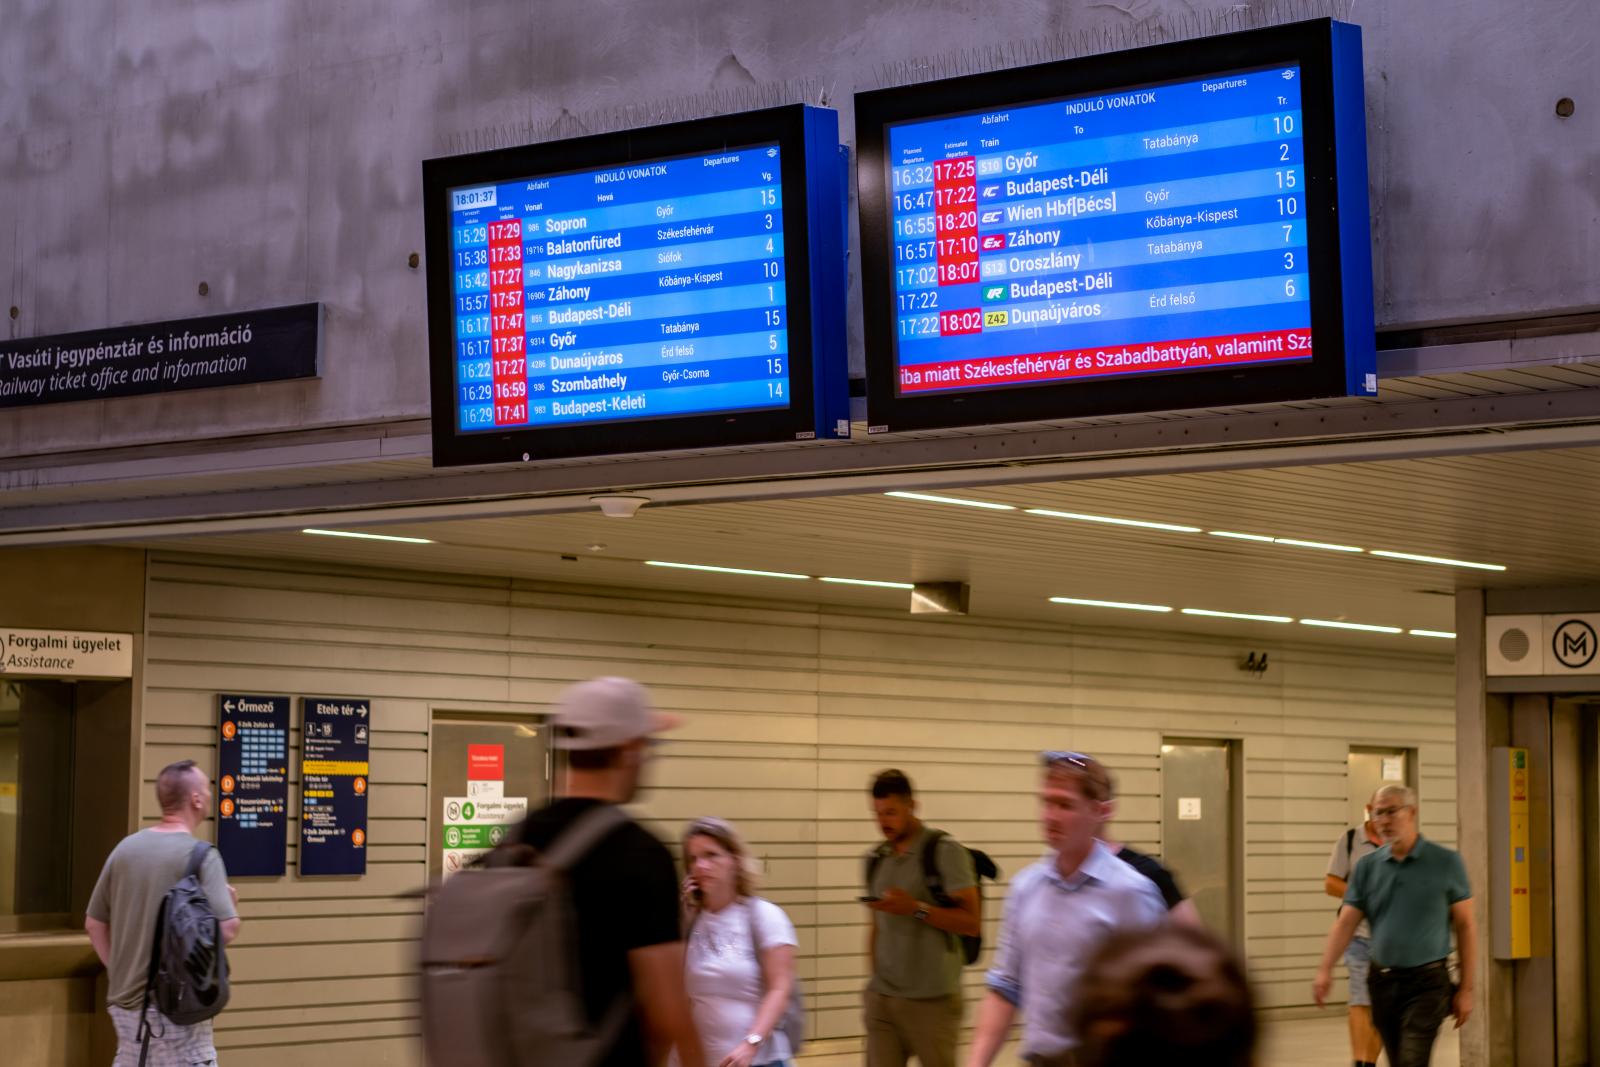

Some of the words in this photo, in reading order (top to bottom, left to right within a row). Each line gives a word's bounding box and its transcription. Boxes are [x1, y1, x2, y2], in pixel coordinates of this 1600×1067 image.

[1066, 98, 1103, 115] INDULÓ
[1107, 92, 1155, 109] VONATOK
[1202, 79, 1247, 92] Departures
[1277, 96, 1288, 105] Tr.
[982, 114, 1009, 125] Abfahrt
[1074, 126, 1083, 134] To
[704, 155, 739, 167] Departures
[894, 167, 932, 186] 16:32
[935, 161, 975, 180] 17:25
[981, 162, 999, 172] S10
[1006, 153, 1038, 173] Győr
[1144, 134, 1198, 149] Tatabánya
[1273, 116, 1294, 135] 10
[981, 138, 999, 148] Train
[527, 181, 549, 191] Abfahrt
[595, 171, 625, 184] INDULÓ
[628, 166, 667, 179] VONATOK
[762, 172, 773, 181] Vg.
[895, 192, 933, 211] 16:47
[936, 186, 976, 206] 17:22
[1007, 168, 1108, 197] Budapest-Déli
[1280, 144, 1289, 161] 2
[456, 191, 493, 206] 18:01:37
[525, 203, 543, 211] Vonat
[597, 194, 613, 202] Hová
[896, 217, 934, 236] 16:55
[937, 211, 977, 231] 18:20
[982, 211, 1002, 223] EC
[1007, 203, 1042, 222] Wien
[1047, 192, 1116, 217] Hbf[Bécs]
[1146, 189, 1169, 205] Győr
[1276, 170, 1296, 188] 15
[458, 228, 486, 245] 15:29
[491, 223, 520, 240] 17:29
[546, 217, 586, 234] Sopron
[657, 206, 674, 218] Győr
[761, 189, 775, 205] 15
[897, 242, 936, 260] 16:57
[938, 237, 978, 256] 17:10
[983, 238, 1003, 248] Ex
[1008, 230, 1060, 247] Záhony
[1146, 208, 1238, 229] Kőbánya-Kispest
[1277, 198, 1297, 216] 10
[458, 250, 487, 266] 15:38
[491, 246, 521, 261] 17:33
[547, 233, 621, 256] Balatonfüred
[658, 224, 714, 240] Székesfehérvár
[766, 214, 772, 229] 3
[899, 268, 937, 286] 17:02
[939, 262, 978, 281] 18:07
[1010, 253, 1080, 272] Oroszlány
[1148, 241, 1203, 255] Tatabánya
[1282, 225, 1292, 243] 7
[459, 273, 487, 288] 15:42
[492, 269, 522, 284] 17:27
[548, 259, 622, 280] Nagykanizsa
[658, 251, 681, 264] Siófok
[766, 238, 773, 253] 4
[900, 292, 938, 310] 17:22
[1011, 273, 1112, 299] Budapest-Déli
[1284, 253, 1294, 269] 3
[460, 295, 488, 311] 15:57
[493, 291, 522, 307] 17:57
[548, 287, 590, 302] Záhony
[659, 271, 723, 288] Kőbánya-Kispest
[764, 262, 778, 278] 10
[461, 318, 489, 333] 16:17
[493, 314, 523, 330] 17:47
[549, 302, 631, 324] Budapest-Déli
[768, 286, 774, 301] 1
[901, 317, 939, 335] 17:22
[941, 313, 981, 331] 18:02
[988, 314, 1005, 324] Z42
[1012, 303, 1101, 325] Dunaújváros
[1150, 296, 1166, 308] Érd
[1170, 293, 1195, 306] felső
[1285, 281, 1295, 297] 6
[8, 347, 51, 369] Vasúti
[55, 338, 143, 370] jegypénztár
[148, 338, 164, 355] és
[169, 324, 252, 352] információ
[461, 340, 489, 356] 16:17
[494, 337, 523, 352] 17:37
[530, 337, 545, 346] 9314
[550, 331, 576, 350] Győr
[661, 322, 699, 334] Tatabánya
[765, 310, 780, 326] 15
[50, 369, 87, 391] ticket
[91, 366, 128, 391] office
[132, 362, 159, 384] and
[163, 354, 247, 381] information
[462, 363, 491, 378] 16:22
[495, 359, 524, 375] 17:27
[551, 352, 623, 370] Dunaújváros
[661, 347, 673, 358] Érd
[676, 344, 694, 356] felső
[770, 335, 777, 350] 5
[925, 367, 960, 382] miatt
[965, 355, 1071, 379] Székesfehérvár
[1075, 355, 1092, 368] és
[1096, 342, 1211, 367] Szabadbattyán,
[1216, 336, 1283, 356] valamint
[463, 385, 491, 400] 16:29
[496, 382, 525, 397] 16:59
[552, 373, 627, 393] Szombathely
[663, 369, 709, 383] Győr-Csorna
[767, 358, 781, 374] 15
[464, 407, 492, 423] 16:29
[497, 404, 525, 420] 17:41
[553, 394, 645, 416] Budapest-Keleti
[768, 383, 782, 398] 14
[7, 654, 74, 669] Assistance
[8, 633, 68, 651] Forgalmi
[73, 636, 121, 653] ügyelet
[238, 700, 273, 713] Őrmező
[317, 704, 338, 714] Etele
[342, 705, 354, 715] tér
[226, 726, 231, 734] C
